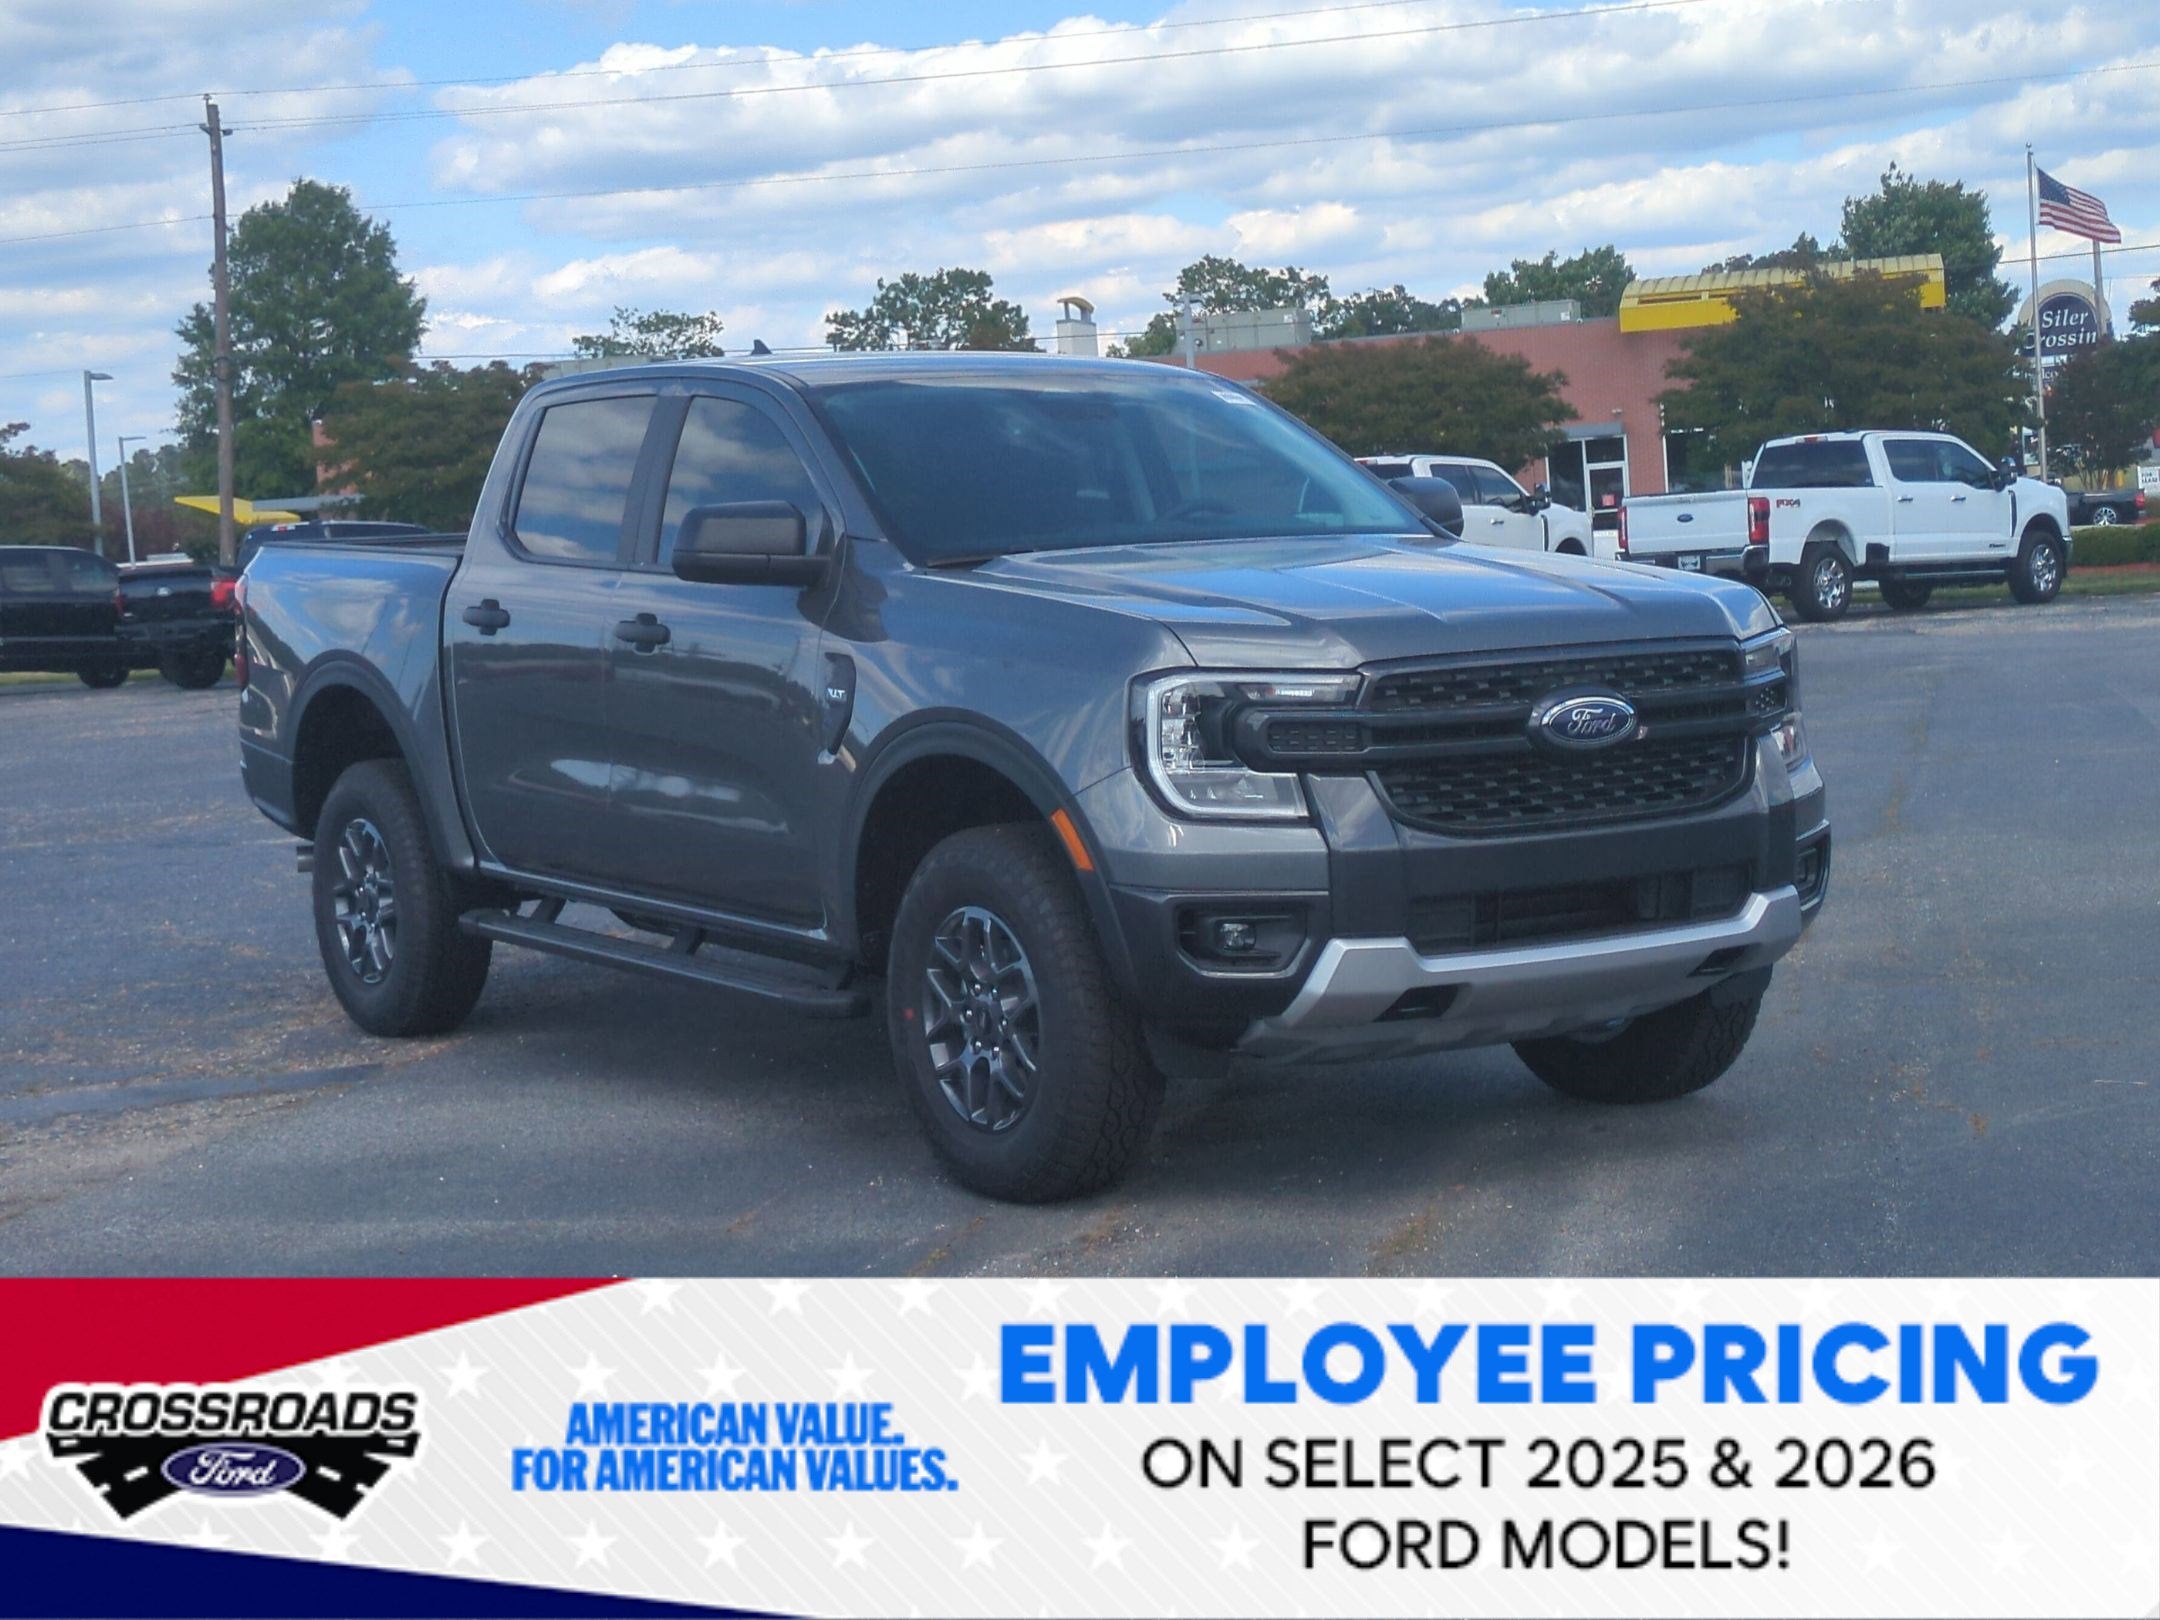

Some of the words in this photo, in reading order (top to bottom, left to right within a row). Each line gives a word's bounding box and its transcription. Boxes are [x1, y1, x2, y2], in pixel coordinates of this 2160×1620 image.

[2041, 308, 2088, 328] Siler
[2024, 328, 2098, 350] Crossin
[1567, 708, 1617, 735] Ford
